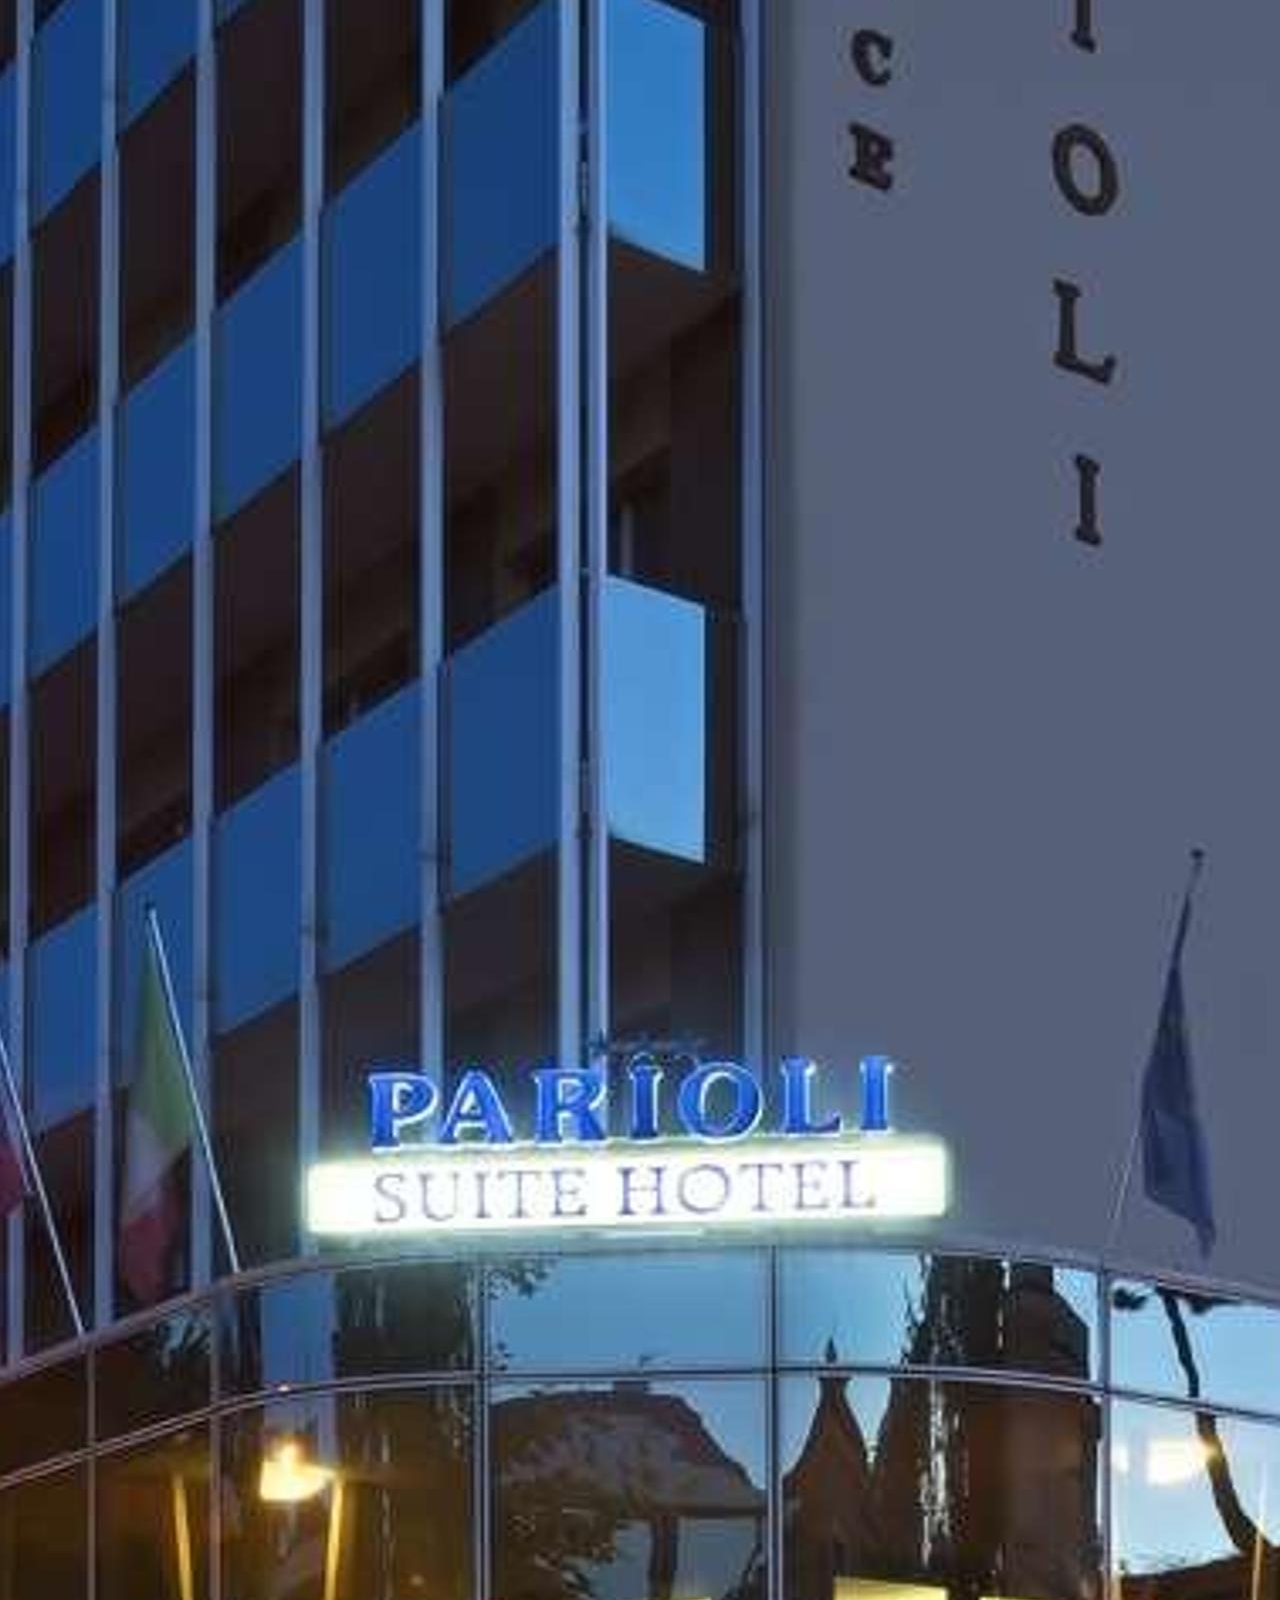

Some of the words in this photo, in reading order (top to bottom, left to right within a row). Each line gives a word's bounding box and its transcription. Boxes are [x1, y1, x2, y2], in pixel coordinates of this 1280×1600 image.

[368, 1054, 894, 1151] PARIOLI
[373, 1168, 587, 1223] SUITE
[617, 1159, 876, 1216] HOTEL
